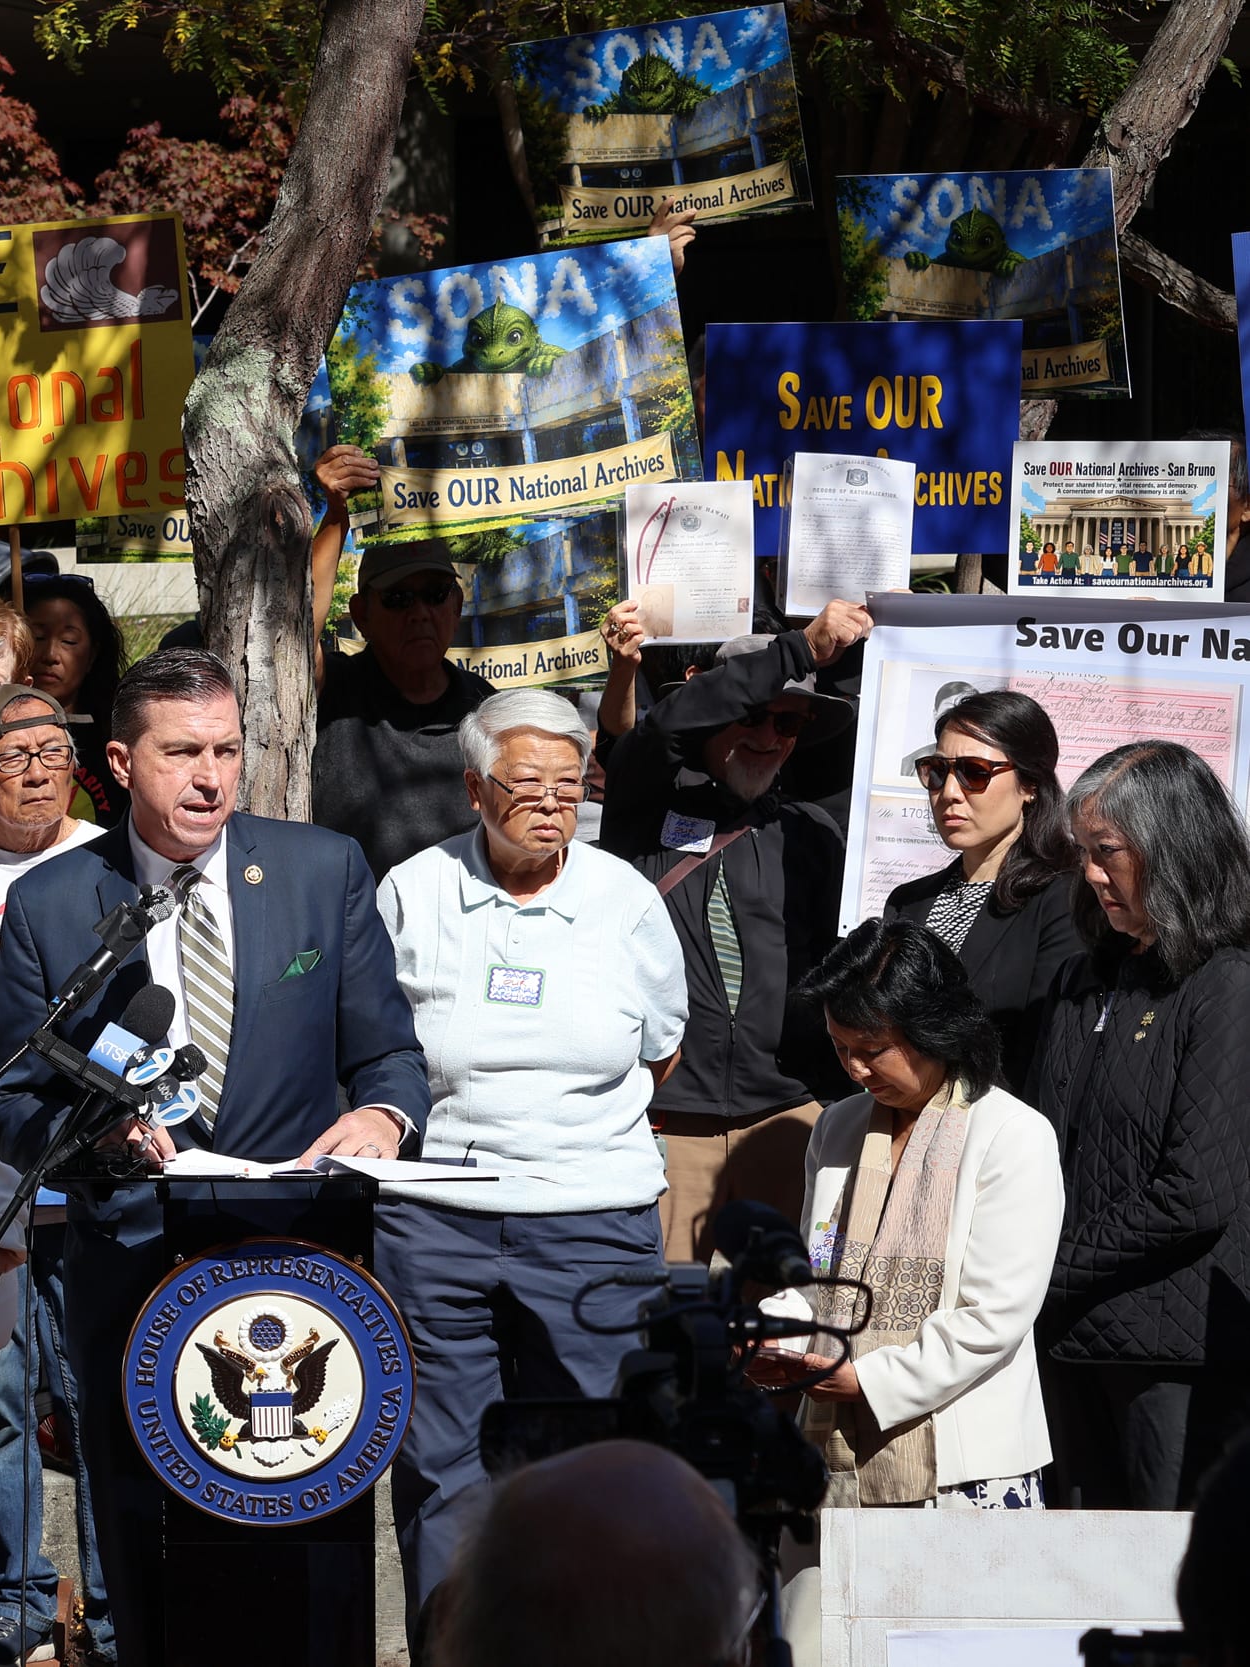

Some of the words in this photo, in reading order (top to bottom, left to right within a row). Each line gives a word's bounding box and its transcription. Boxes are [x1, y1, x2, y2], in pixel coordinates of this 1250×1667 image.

[565, 22, 732, 93] SONA
[572, 198, 608, 220] Save
[614, 195, 656, 218] OUR
[729, 175, 786, 205] Archives
[887, 176, 1053, 240] SONA
[387, 256, 598, 345] SONA
[1043, 355, 1101, 379] Archives
[777, 371, 853, 431] SAVE
[865, 374, 944, 430] OUR
[393, 482, 440, 510] Save
[447, 478, 502, 508] OUR
[509, 466, 588, 502] National
[593, 454, 665, 491] Archives
[1023, 461, 1047, 477] Save
[1049, 461, 1073, 477] OUR
[1075, 461, 1116, 477] National
[1118, 461, 1159, 477] Archives
[1167, 462, 1185, 477] San
[1187, 462, 1216, 477] Bruno
[1096, 481, 1118, 489] history,
[1132, 481, 1156, 489] records,
[1168, 482, 1199, 490] democracy.
[116, 515, 156, 539] Save
[162, 517, 193, 543] OU
[705, 507, 731, 521] HAWAII
[1032, 577, 1049, 585] Take
[1050, 577, 1073, 585] Action
[1074, 577, 1085, 585] At:
[1092, 578, 1208, 588] saveournationalarchives.org
[1016, 616, 1104, 652] Save
[1117, 623, 1188, 657] Our
[1201, 628, 1250, 662] Na
[455, 652, 528, 680] National
[535, 646, 599, 677] Archives
[134, 1302, 183, 1388] HOUSE
[177, 1273, 210, 1306] OF
[207, 1255, 403, 1376] REPRESENTATIVES
[137, 1396, 203, 1489] UNITED
[200, 1480, 294, 1518] STATES
[299, 1481, 332, 1512] OF
[334, 1384, 404, 1497] AMERICA
